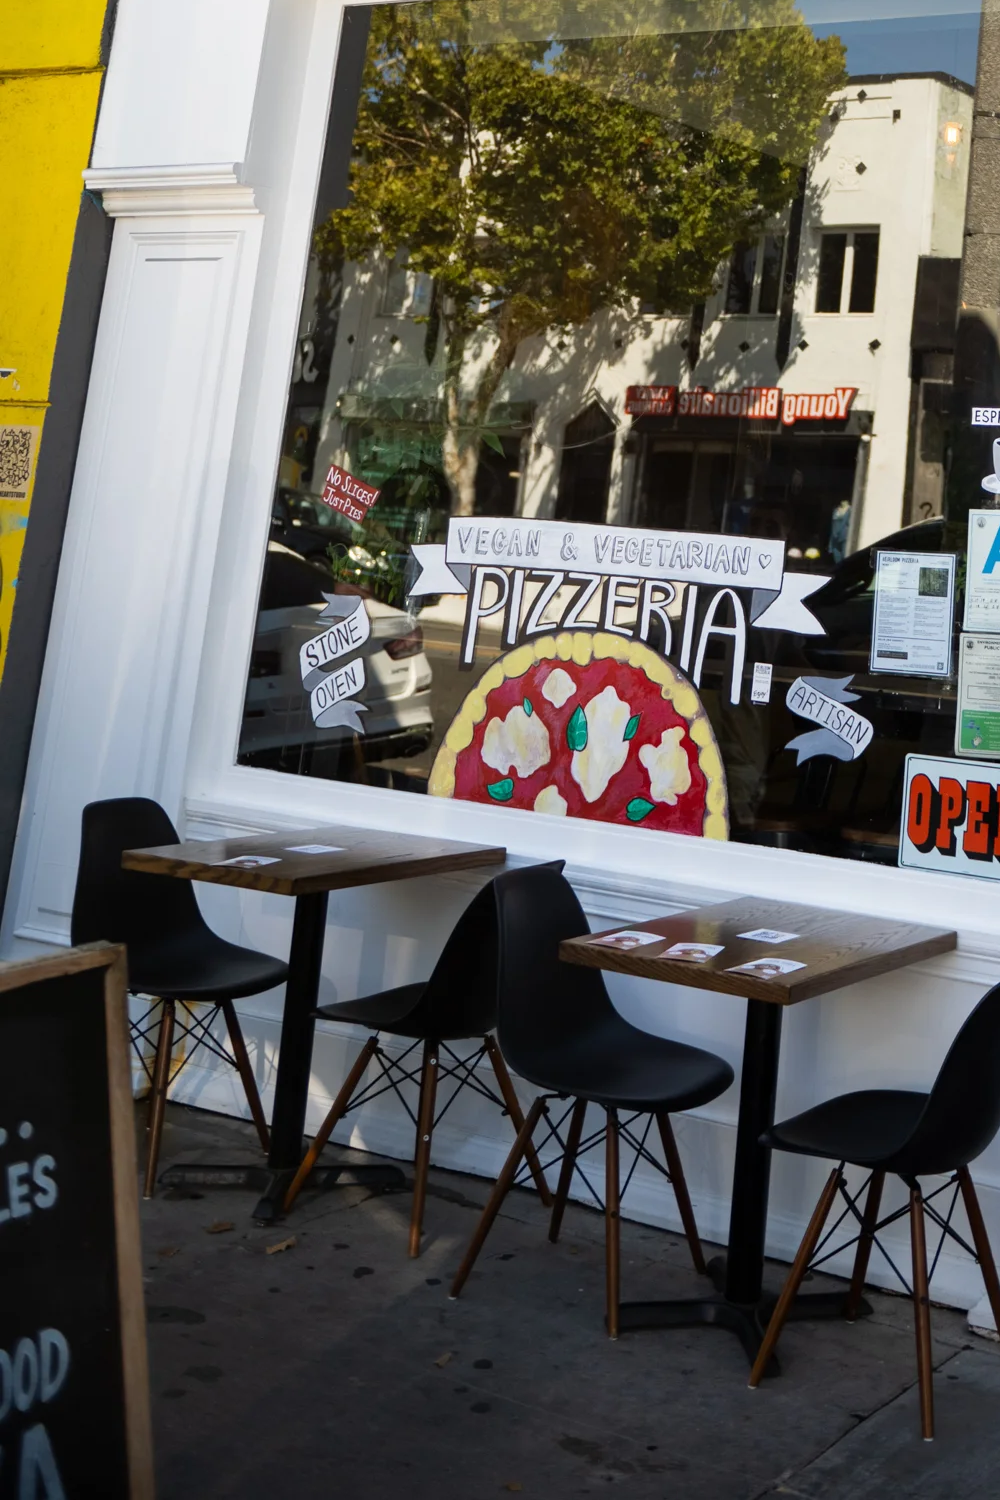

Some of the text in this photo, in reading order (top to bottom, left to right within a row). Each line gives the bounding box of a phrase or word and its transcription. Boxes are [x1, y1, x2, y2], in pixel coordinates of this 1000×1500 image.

[458, 526, 752, 575] VEGAN & VEGETARIAN
[306, 616, 362, 667] STONE
[461, 566, 747, 706] PIZZERIA
[316, 666, 358, 709] OVEN
[790, 684, 870, 745] ARTISAN
